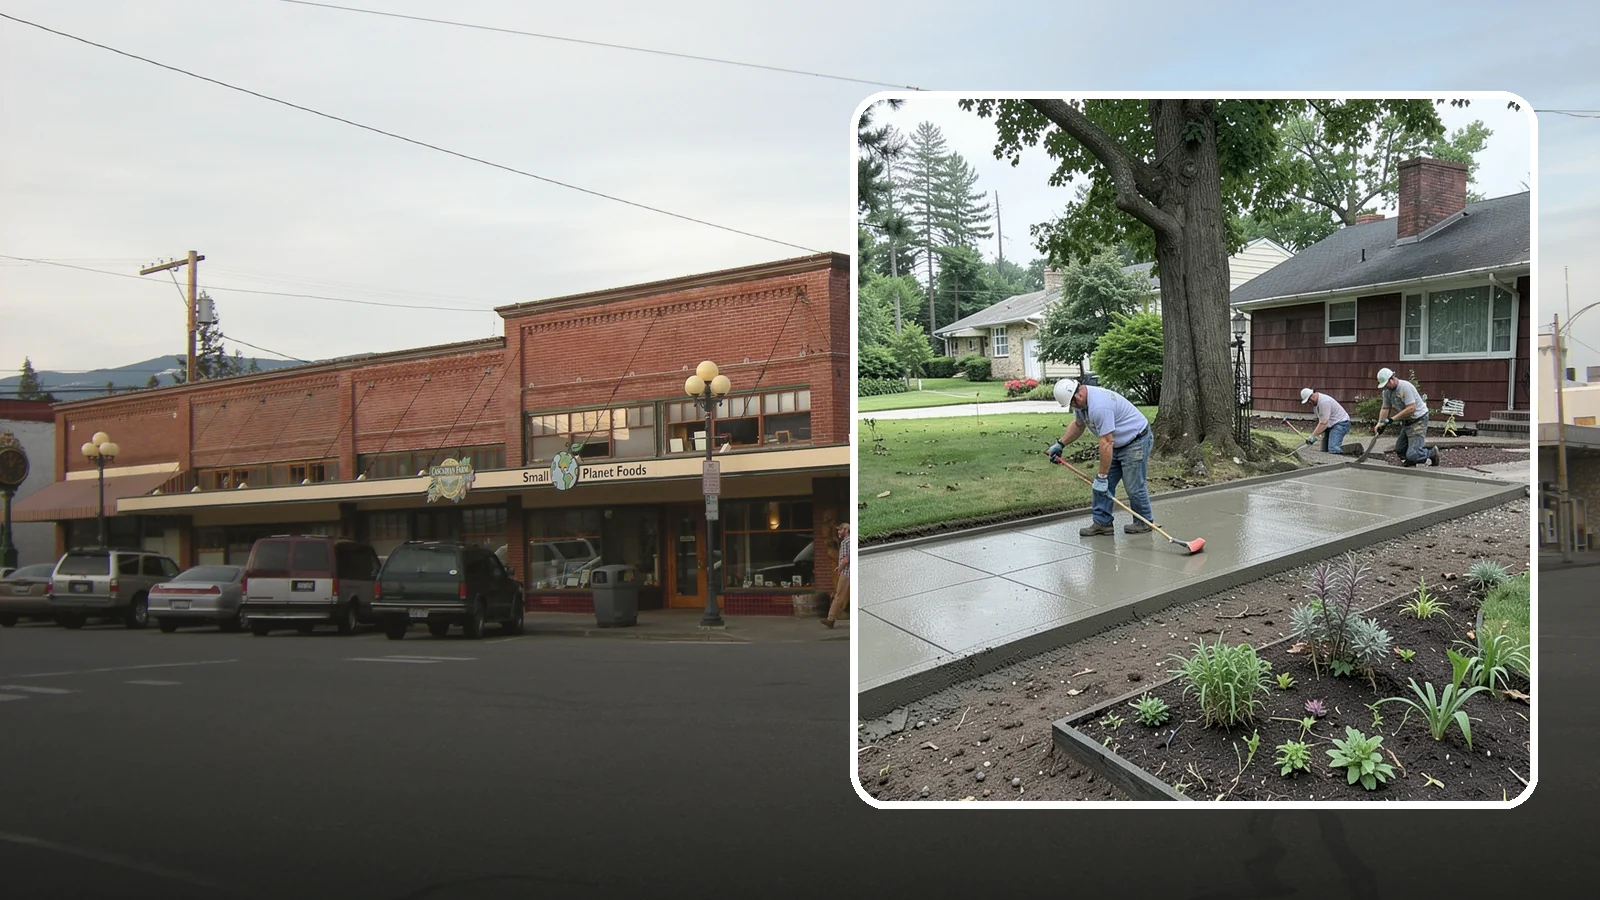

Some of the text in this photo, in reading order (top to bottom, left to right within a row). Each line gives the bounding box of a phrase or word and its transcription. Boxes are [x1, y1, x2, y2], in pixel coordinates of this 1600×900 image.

[523, 464, 647, 483] Small Planet Foods
